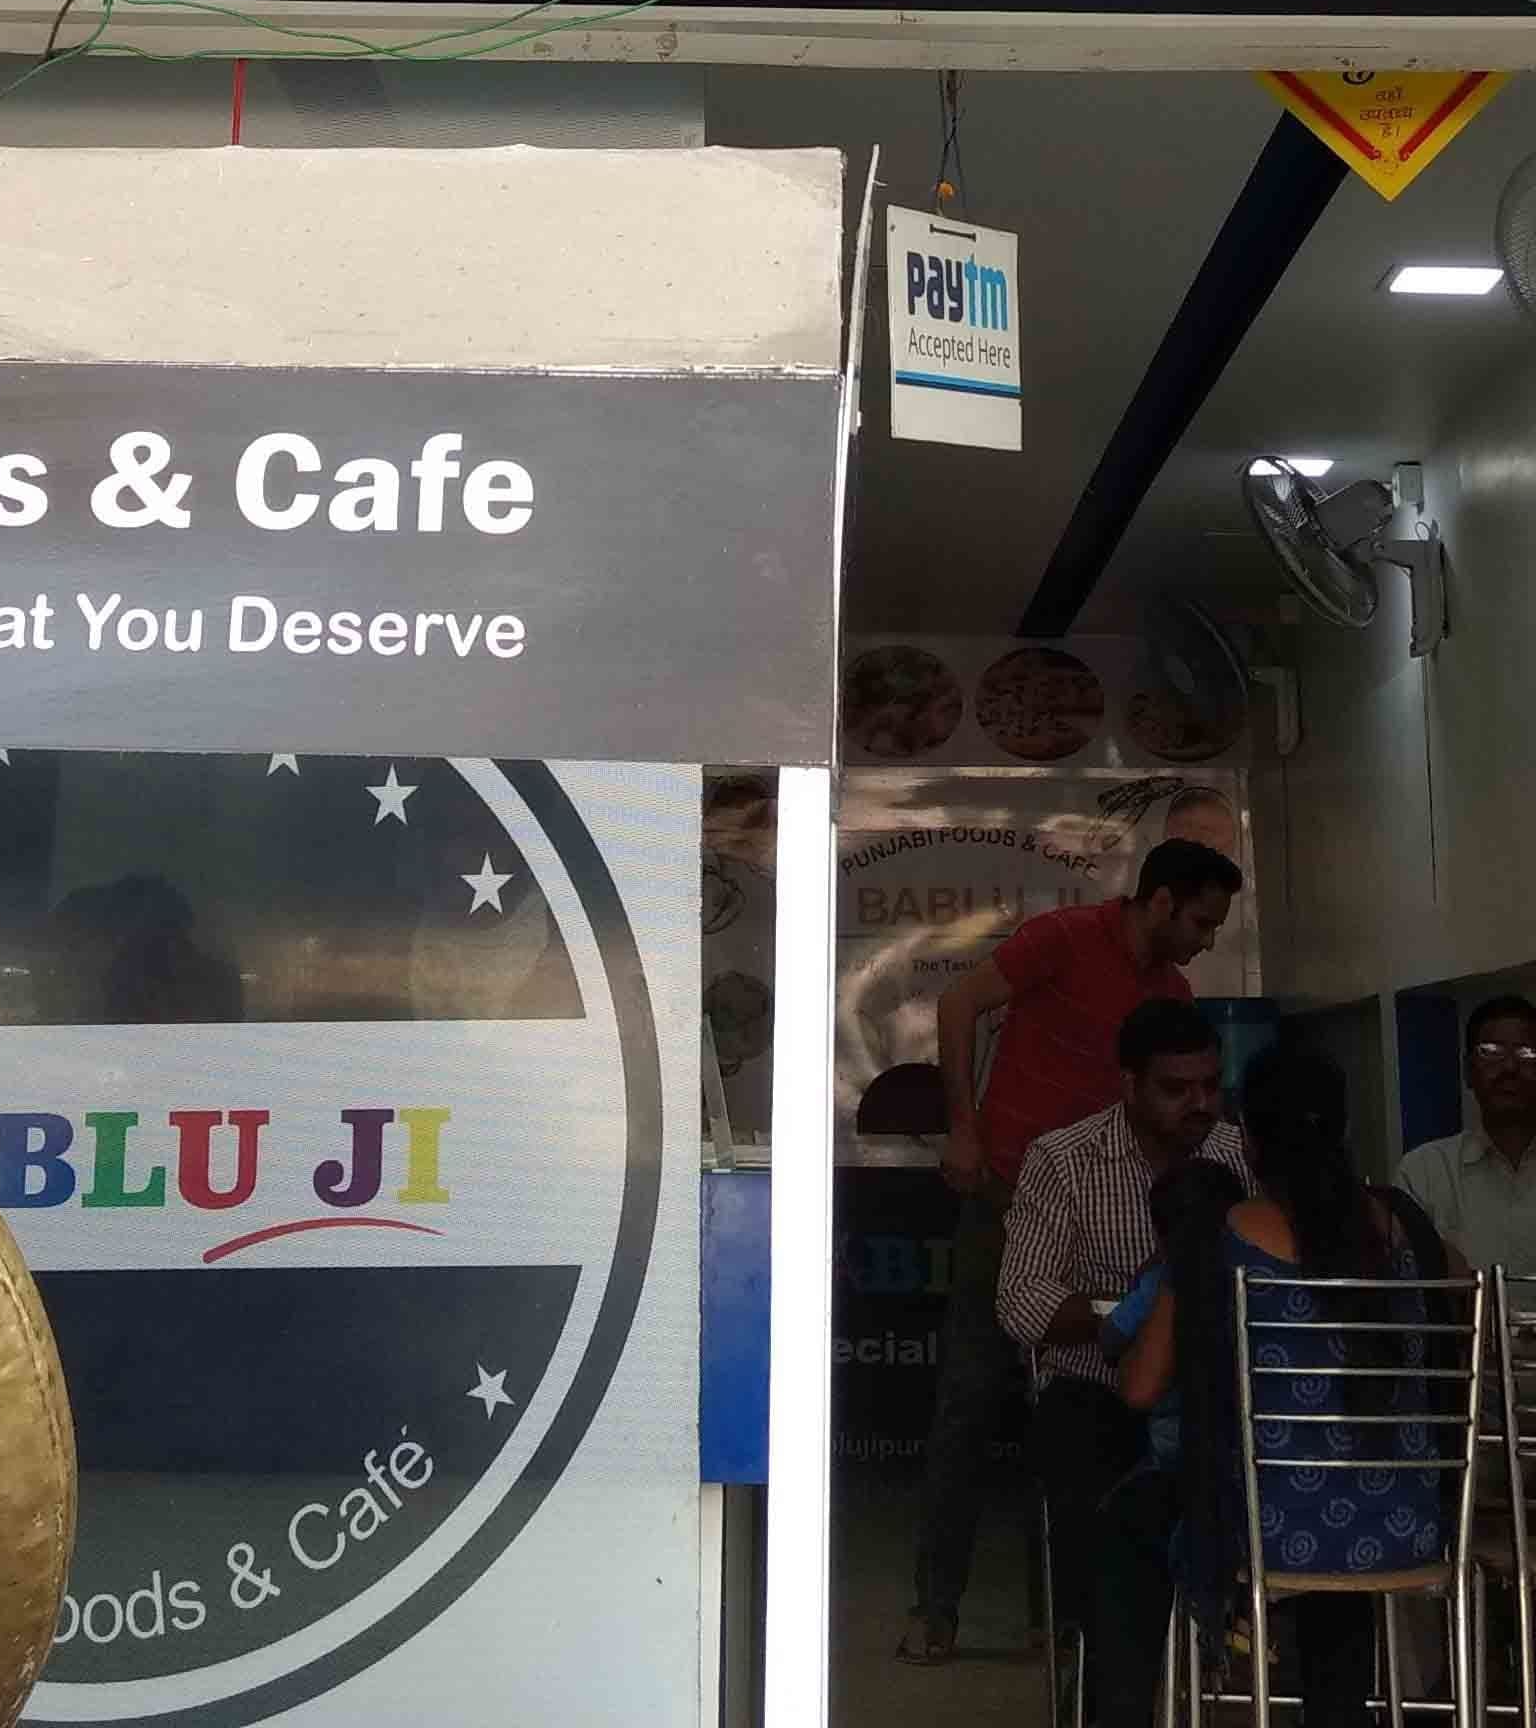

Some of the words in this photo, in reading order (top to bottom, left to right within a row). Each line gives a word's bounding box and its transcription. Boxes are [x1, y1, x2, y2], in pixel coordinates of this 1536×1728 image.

[908, 327, 974, 367] Accepted
[978, 335, 1011, 368] Here
[89, 430, 193, 531] &
[232, 431, 538, 536] Cafe
[74, 592, 206, 654] You
[226, 593, 528, 660] Deserve
[841, 828, 935, 877] PUNJABI
[311, 1106, 452, 1209] JI
[831, 1328, 937, 1366] ecial
[52, 1569, 208, 1644] oods
[226, 1541, 282, 1610] &
[287, 1424, 434, 1571] Café
